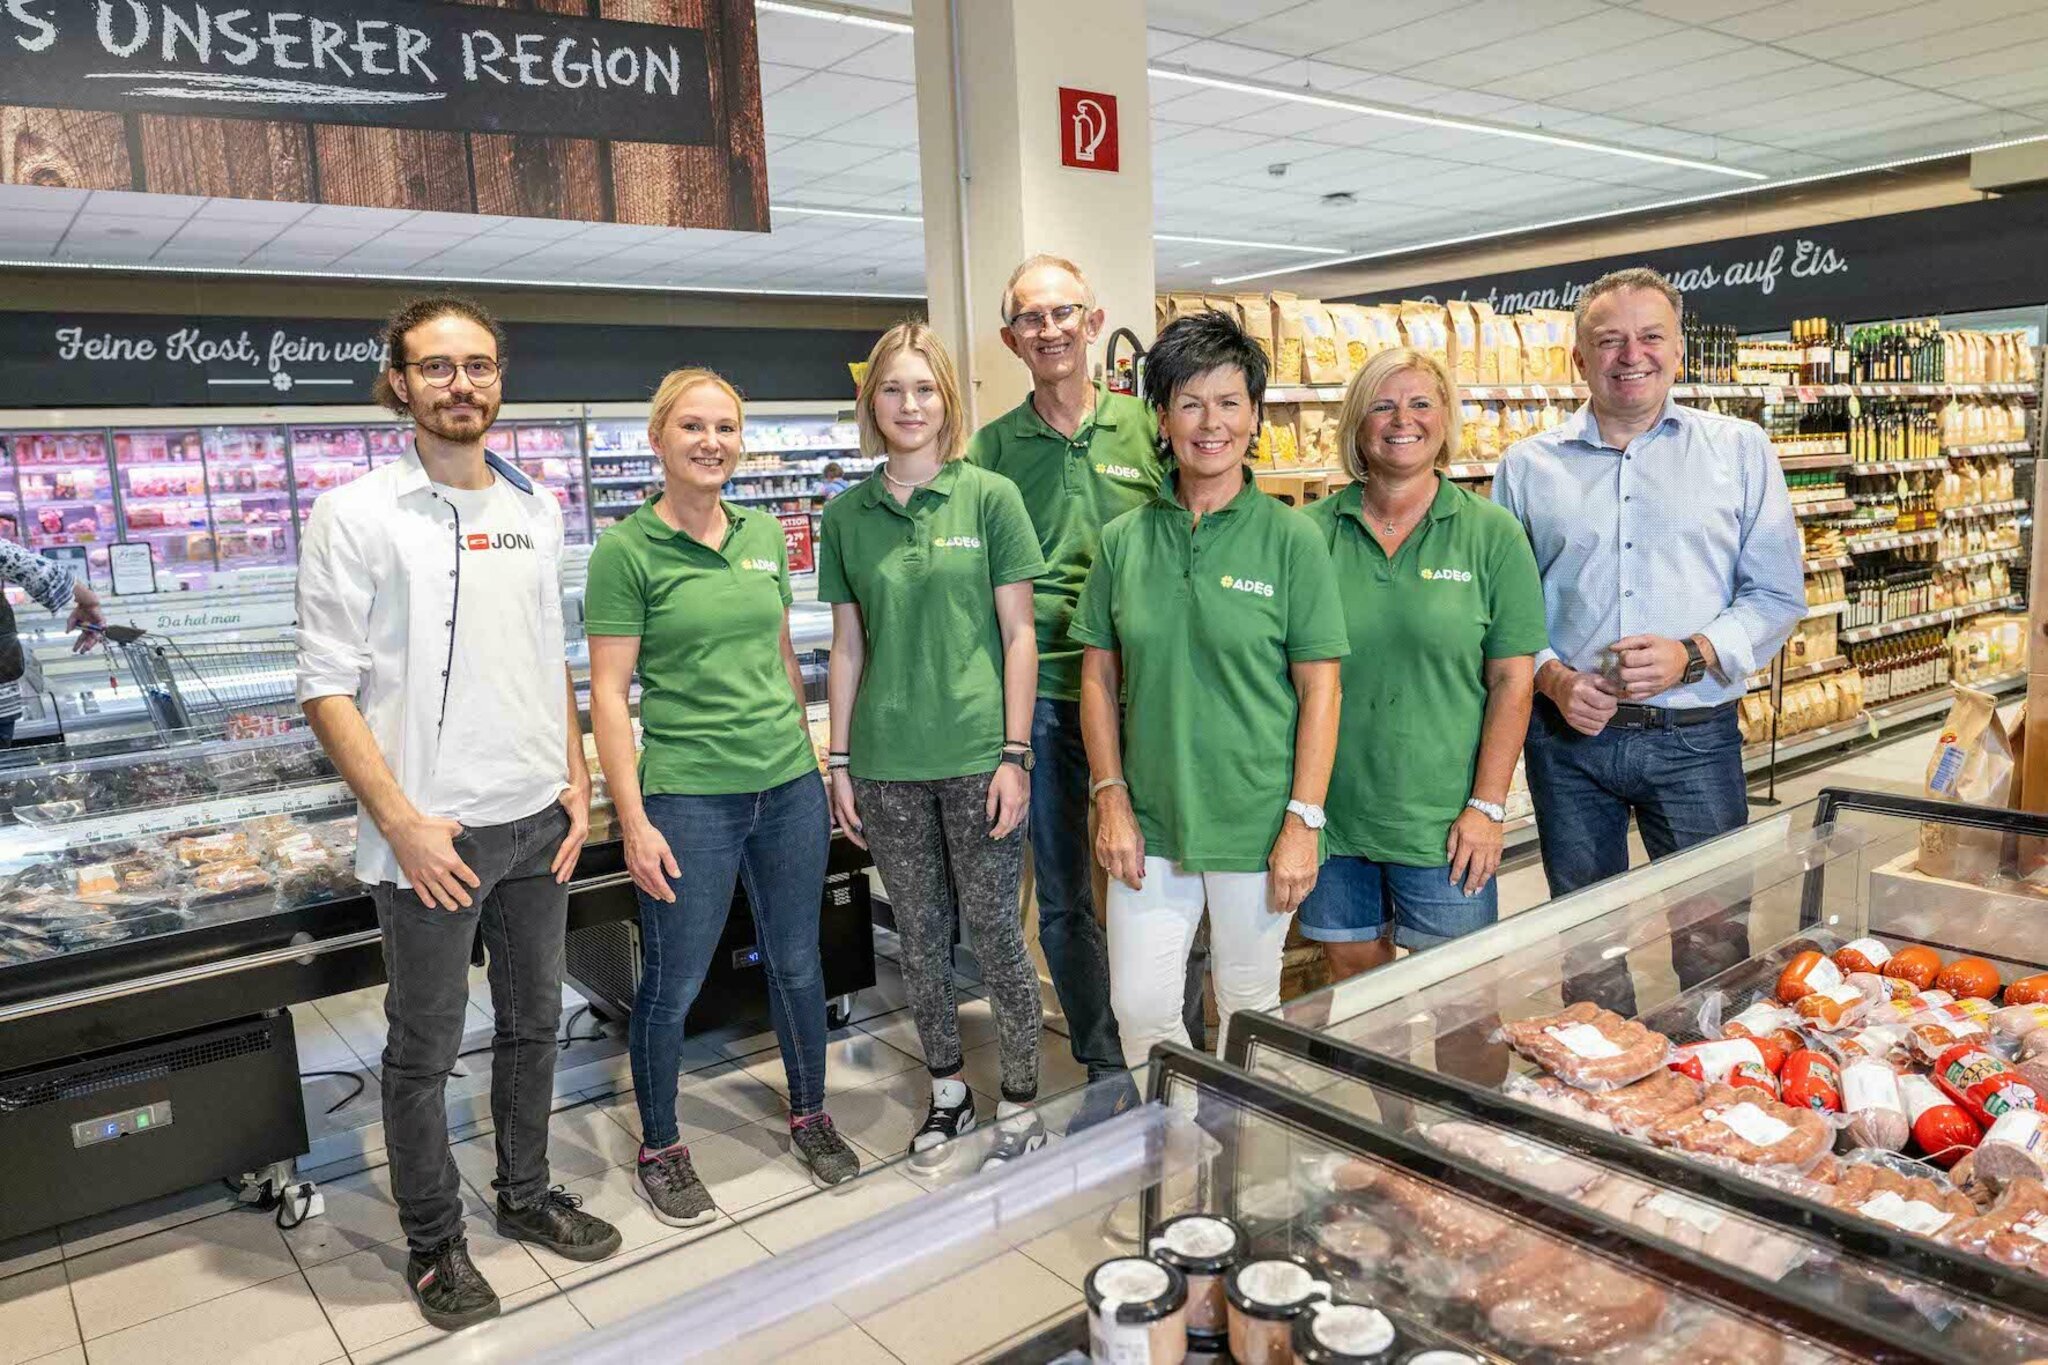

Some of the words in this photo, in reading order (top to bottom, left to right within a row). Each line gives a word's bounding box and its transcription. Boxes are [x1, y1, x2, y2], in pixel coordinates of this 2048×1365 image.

[95, 0, 438, 84] UNSERER
[1724, 245, 1784, 295] auf
[1791, 239, 1848, 278] Eis.
[55, 327, 157, 361] Feine
[166, 328, 260, 366] Kost,
[268, 330, 331, 373] fein
[334, 338, 392, 373] verp
[1106, 464, 1140, 479] ADEG
[781, 517, 809, 528] KTION
[946, 536, 981, 548] ADEG
[1433, 569, 1472, 582] ADEG
[1232, 578, 1274, 597] ADEG
[157, 615, 181, 628] Da
[210, 614, 241, 625] man
